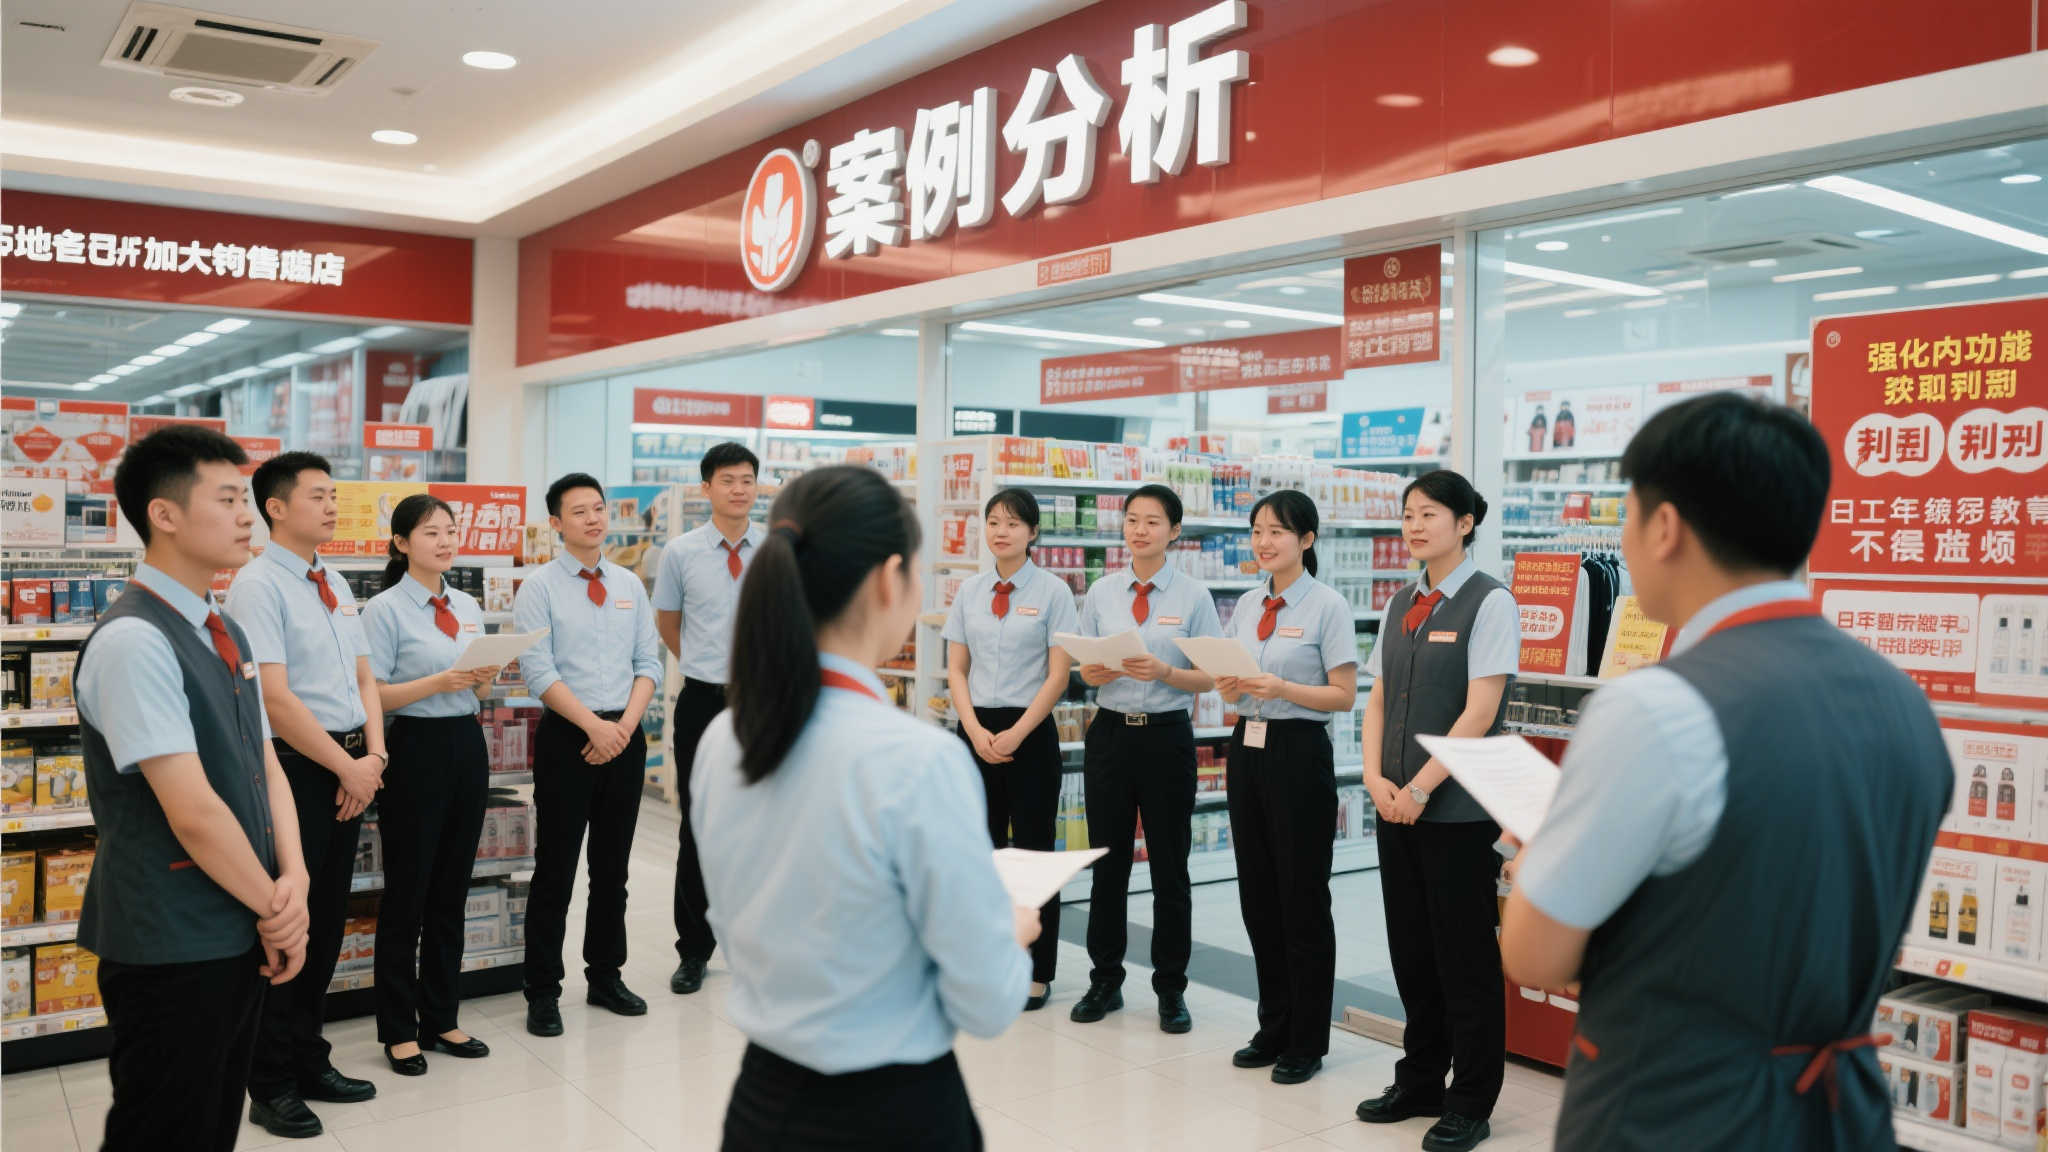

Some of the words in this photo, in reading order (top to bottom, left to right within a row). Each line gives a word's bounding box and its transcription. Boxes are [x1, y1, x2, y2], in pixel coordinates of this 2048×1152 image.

[826, 0, 1250, 259] 案例分析
[1868, 329, 2033, 373] 强化内功能
